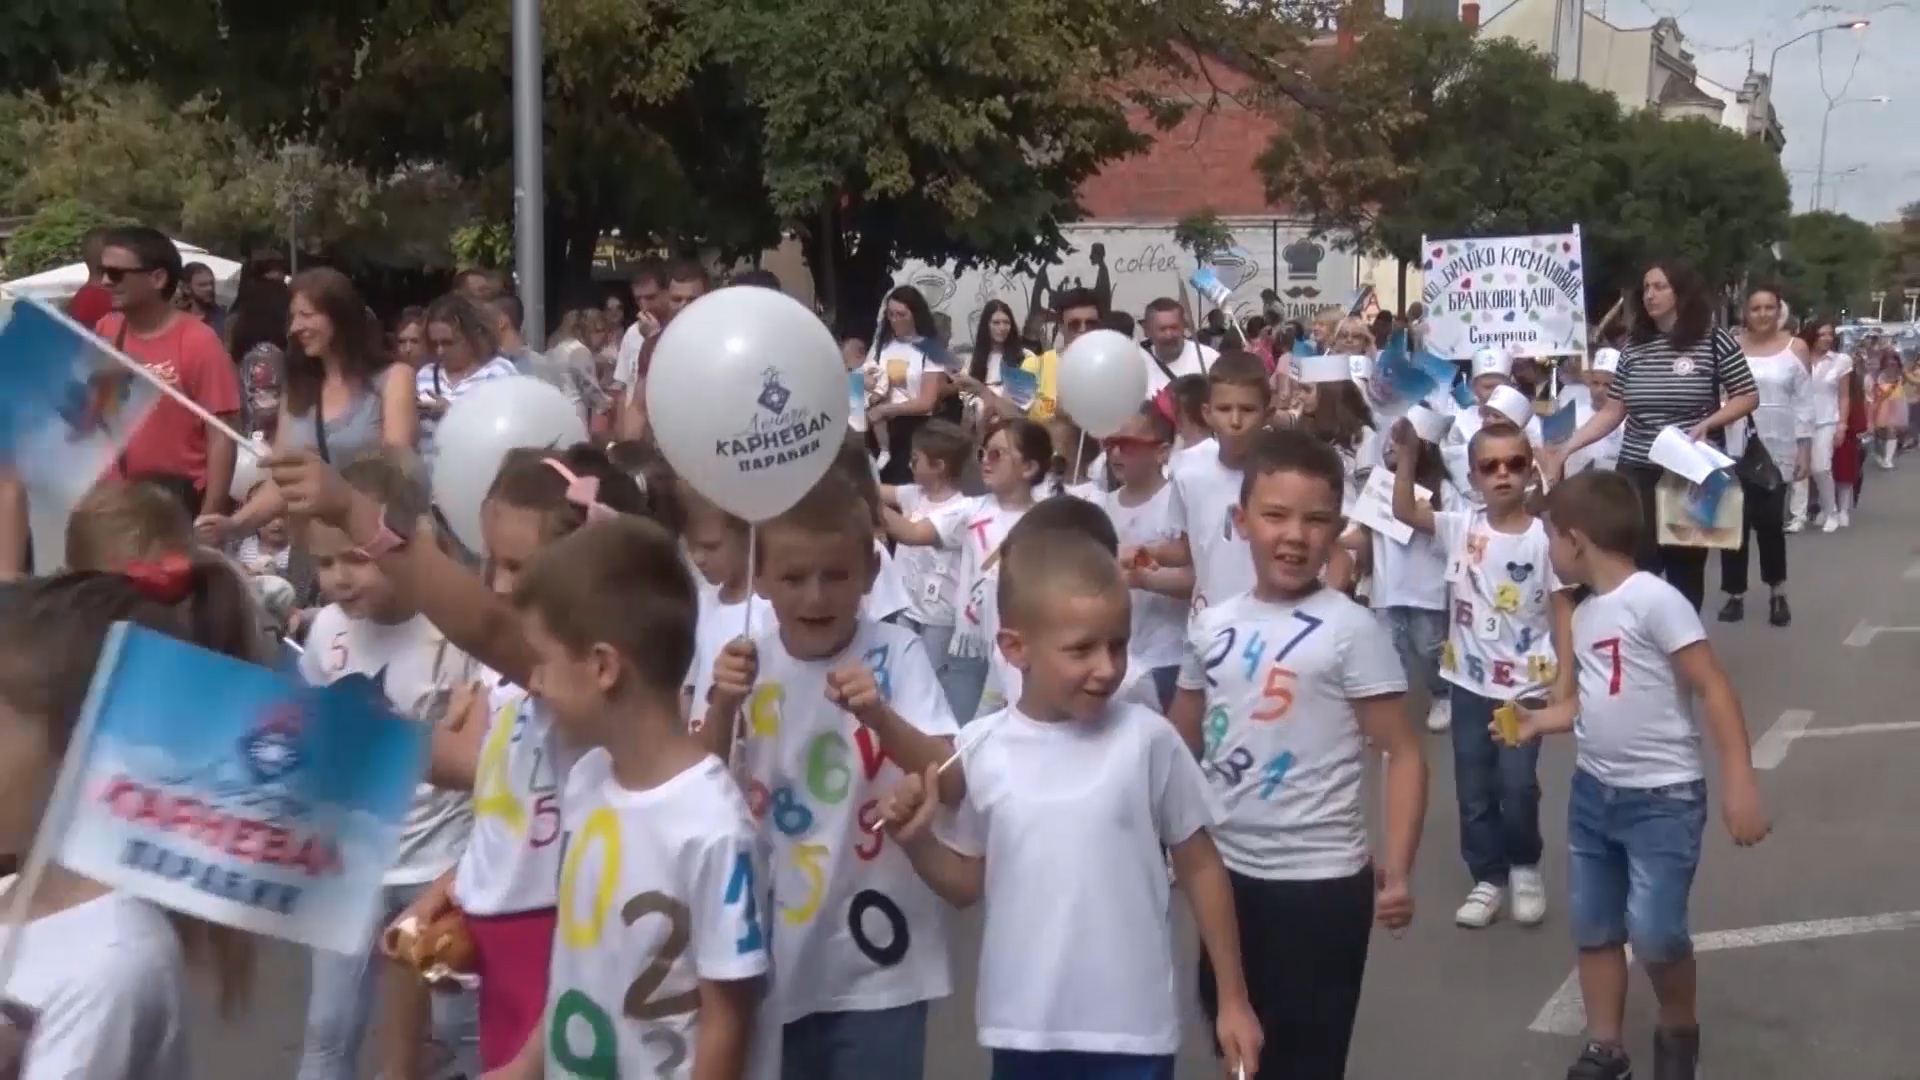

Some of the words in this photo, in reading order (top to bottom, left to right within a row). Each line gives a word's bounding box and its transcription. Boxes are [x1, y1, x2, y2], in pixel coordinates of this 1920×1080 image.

[715, 411, 832, 457] КАРНЕВАЛ
[1486, 617, 1496, 632] 3
[1534, 589, 1544, 604] 2
[1275, 609, 1323, 662] 7
[1250, 666, 1298, 722] 5
[1592, 637, 1622, 696] 7
[806, 730, 852, 804] 6
[529, 793, 561, 848] 5
[773, 787, 813, 837] 8
[724, 852, 763, 955] 1
[783, 845, 829, 927] 5
[621, 890, 702, 1020] 2
[848, 889, 909, 967] 0
